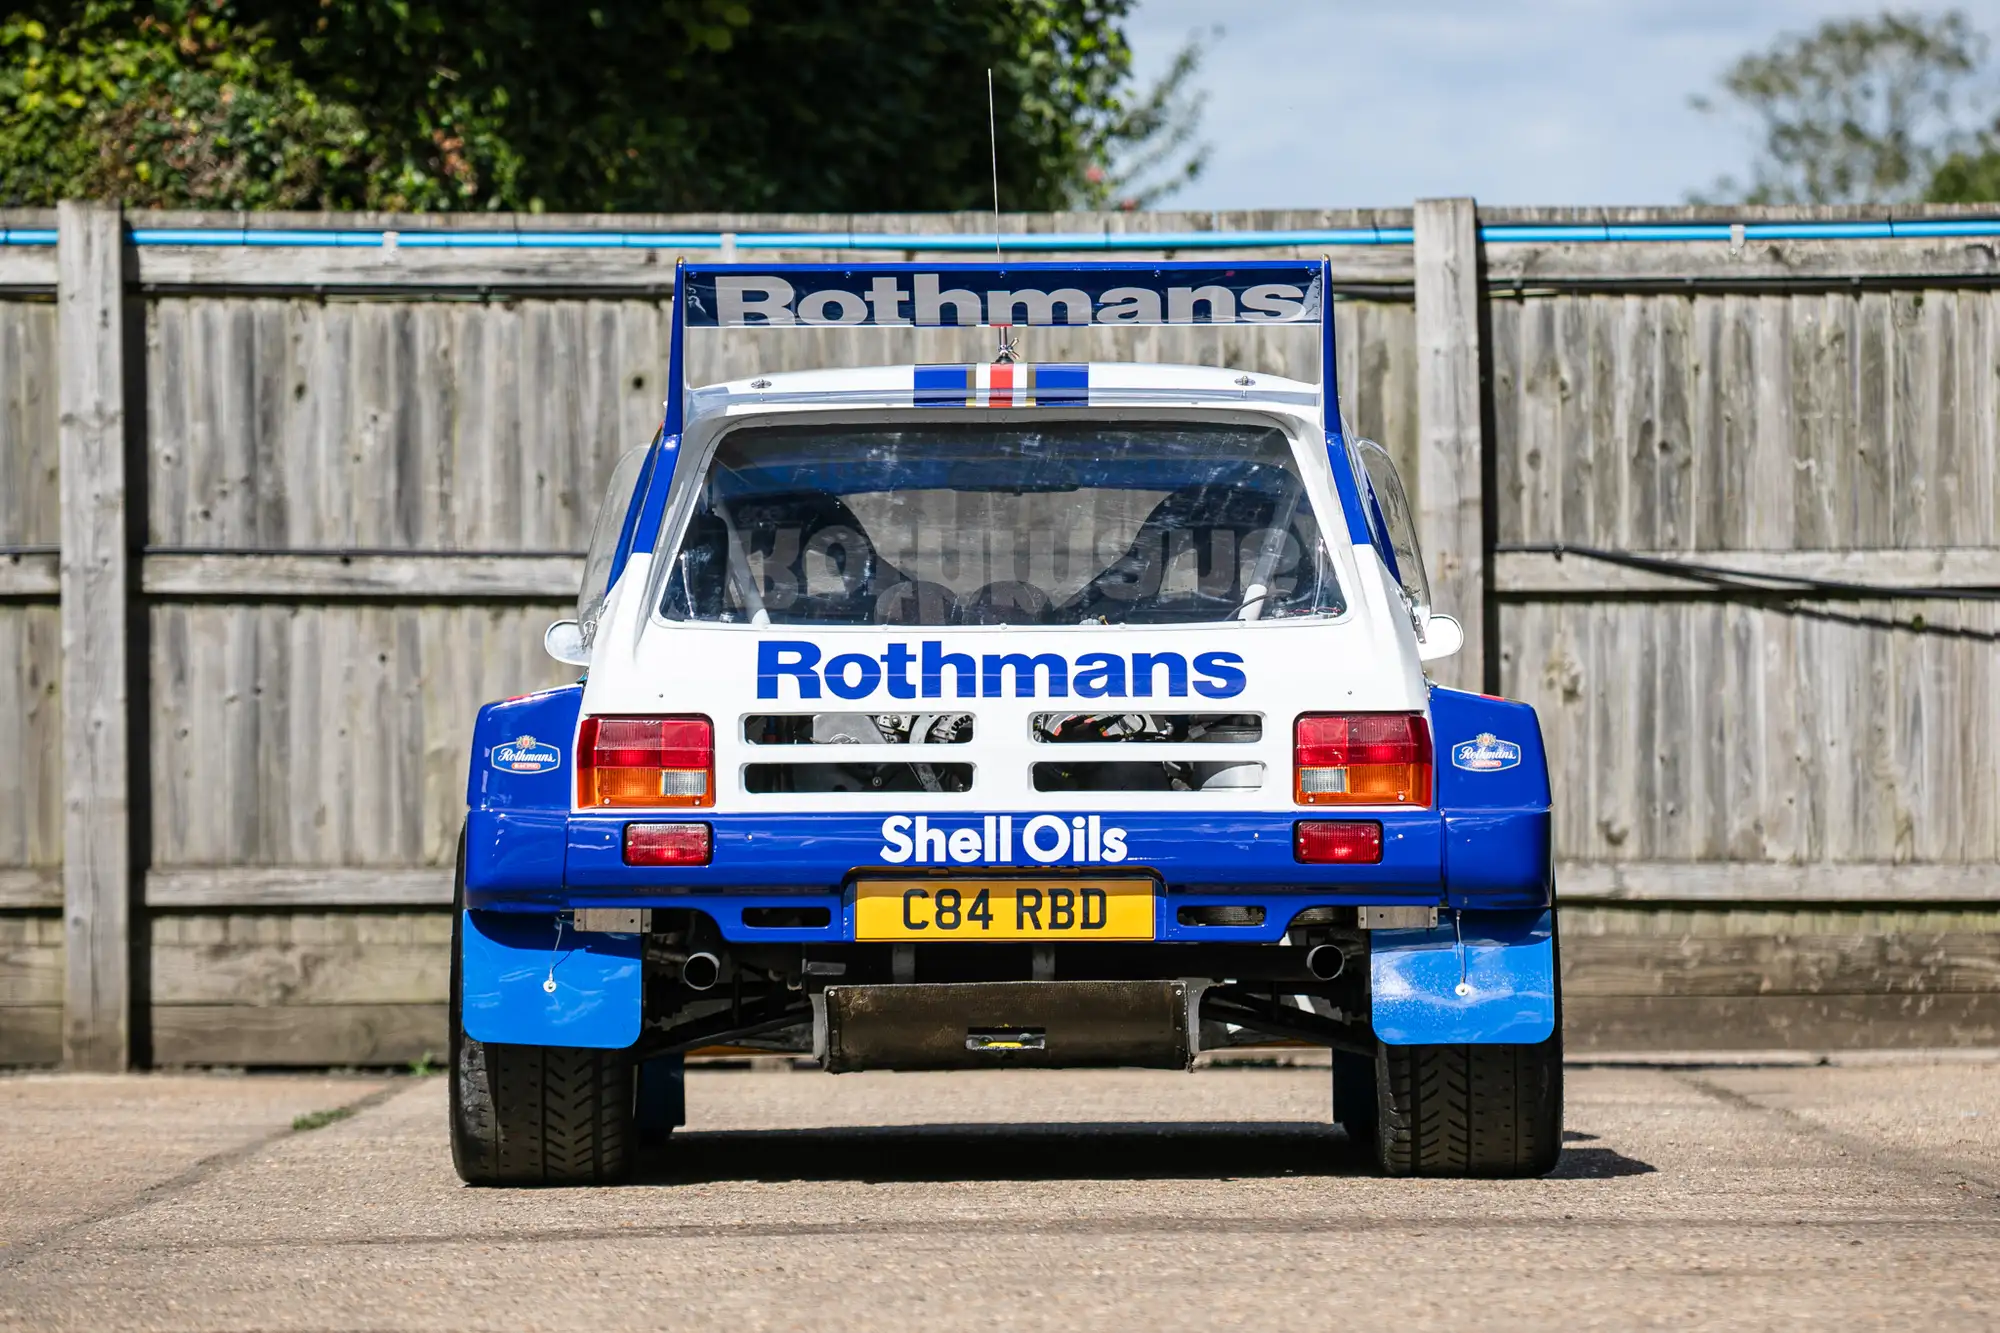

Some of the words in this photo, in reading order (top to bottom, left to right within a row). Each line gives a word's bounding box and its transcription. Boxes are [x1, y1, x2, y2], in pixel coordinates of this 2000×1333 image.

[715, 274, 1307, 325] Rothmans
[757, 640, 1247, 700] Rothmans
[498, 748, 556, 763] Rothmans
[1459, 746, 1517, 760] Rothmans
[880, 815, 1011, 863] Shell
[1022, 815, 1128, 863] Oils
[903, 888, 993, 930] C84
[1016, 888, 1107, 930] RBD
